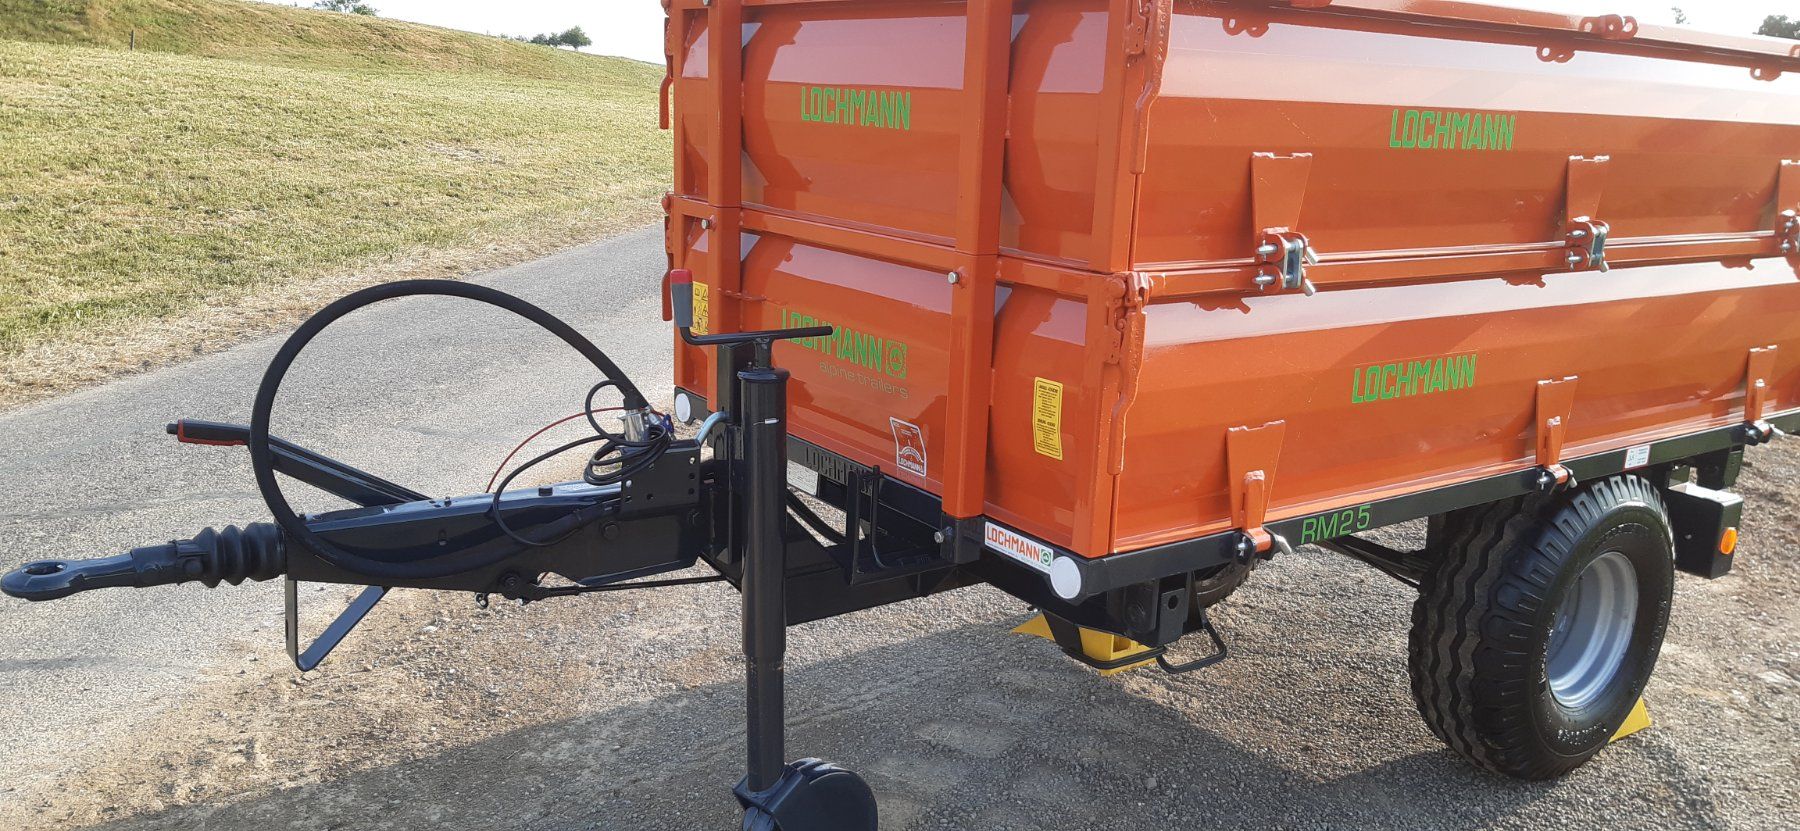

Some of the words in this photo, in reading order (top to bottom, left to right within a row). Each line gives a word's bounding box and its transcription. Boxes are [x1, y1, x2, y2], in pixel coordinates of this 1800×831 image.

[801, 86, 911, 130] LOCHMANN
[1389, 109, 1516, 150] LOCHMANN
[819, 361, 856, 380] alpine
[857, 372, 909, 399] trailers
[1351, 354, 1477, 404] LOCHMANN
[986, 525, 1040, 562] LOCHMANN
